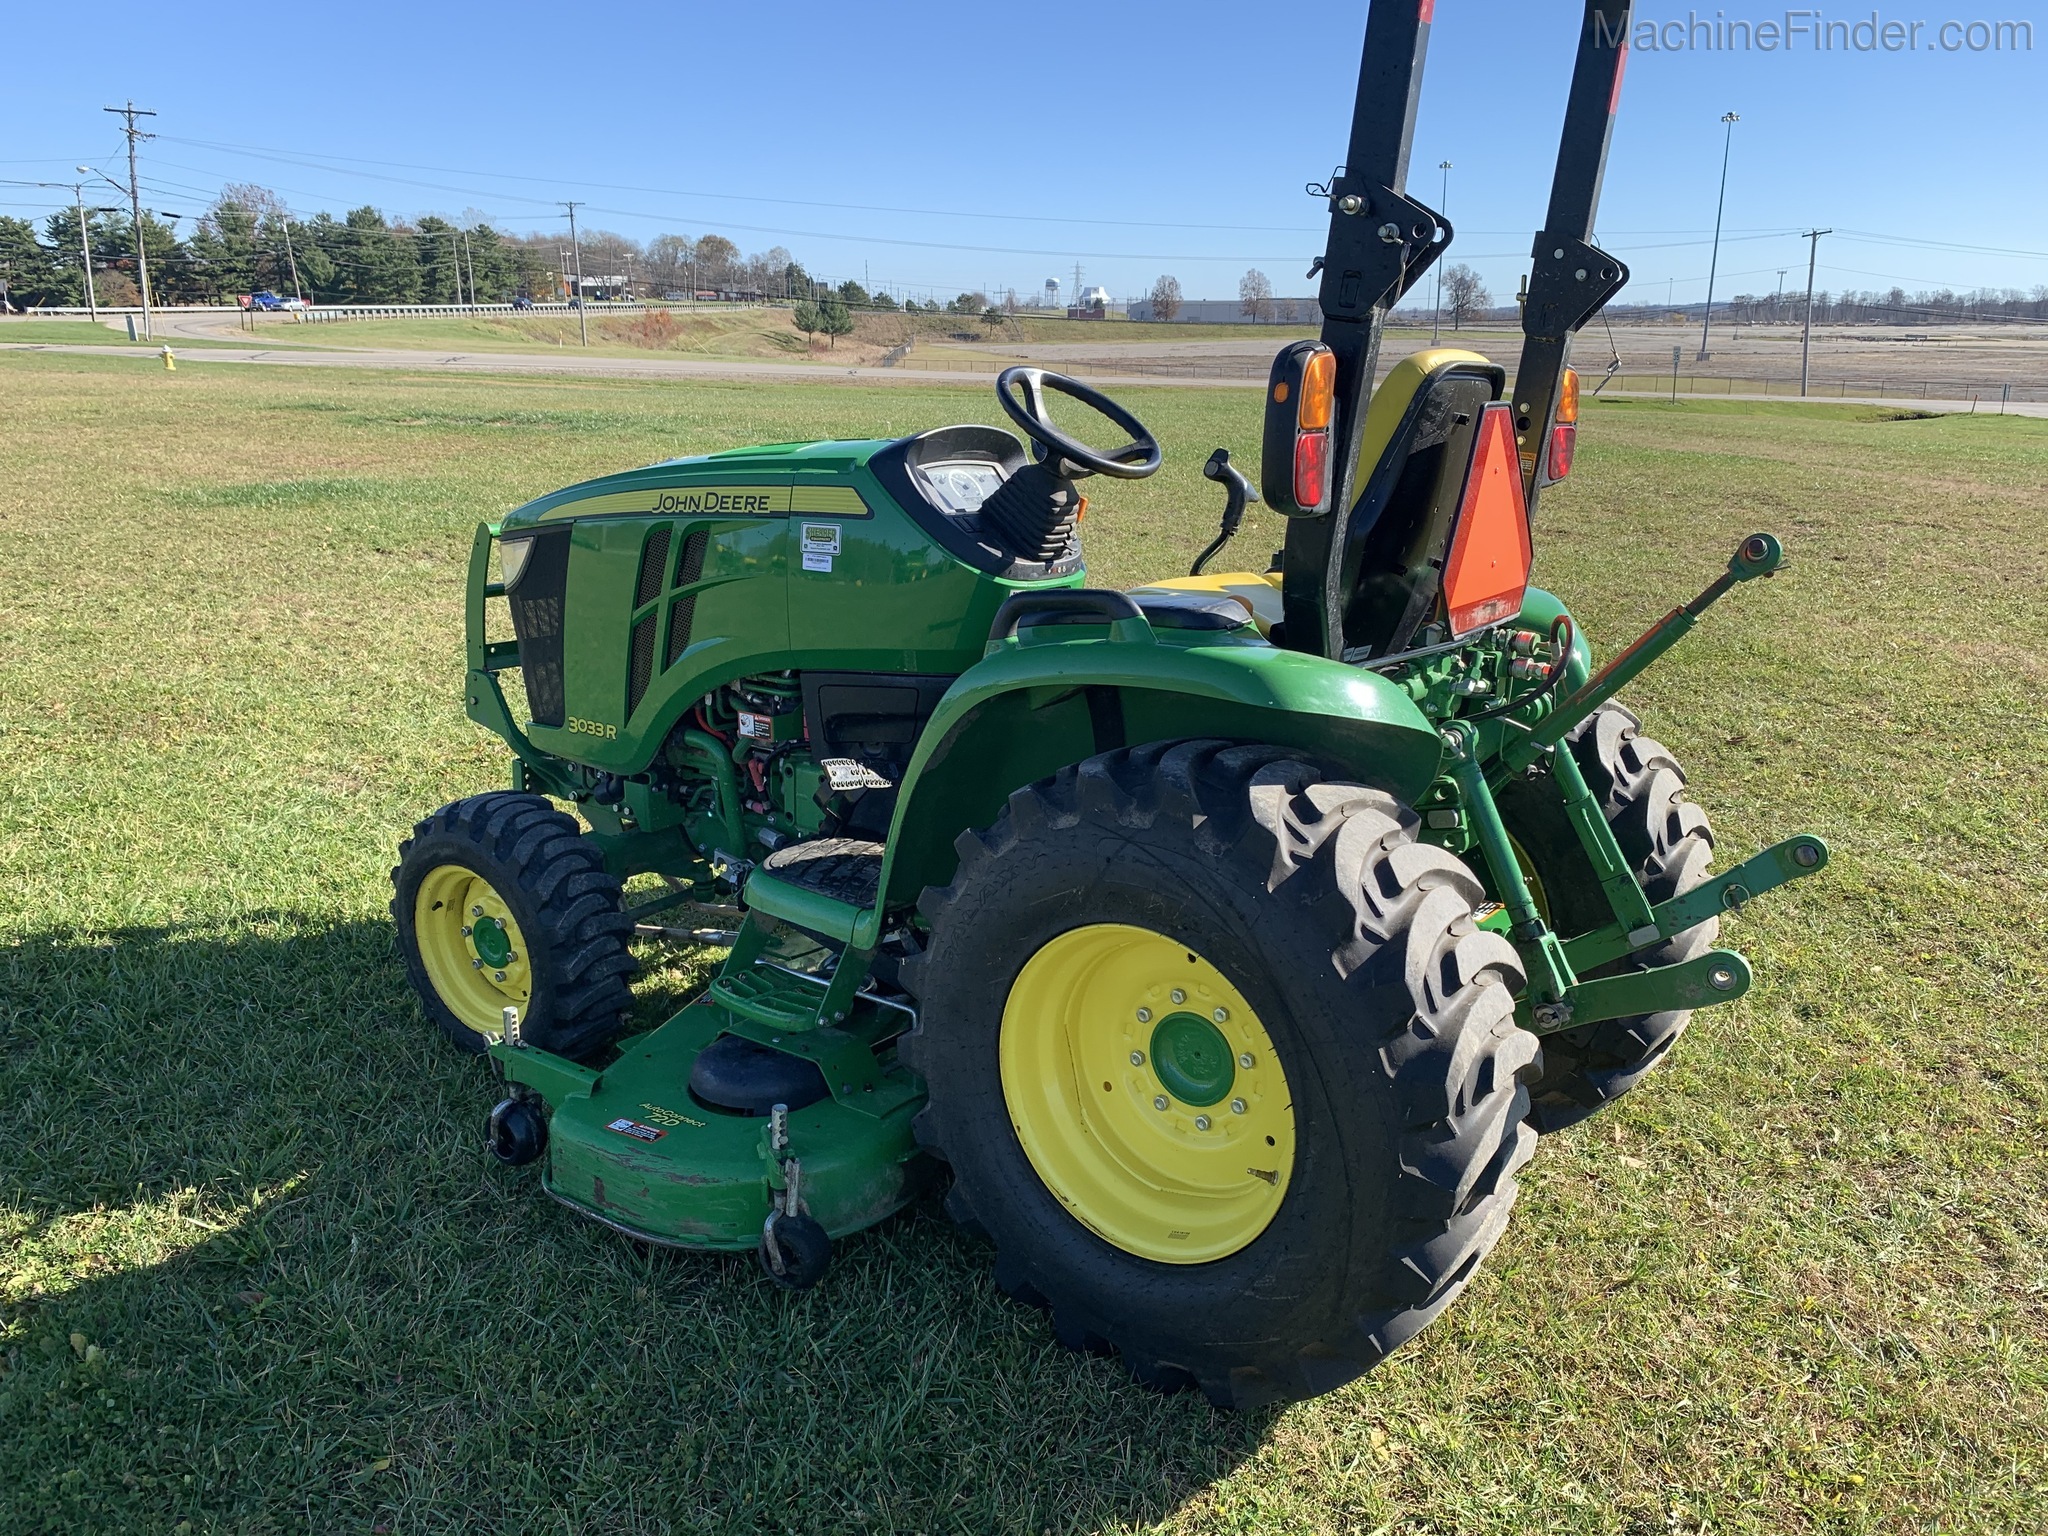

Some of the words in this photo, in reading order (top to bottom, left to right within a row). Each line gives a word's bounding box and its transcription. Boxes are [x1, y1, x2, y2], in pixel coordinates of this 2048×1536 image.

[651, 492, 702, 512] JOHN
[703, 491, 771, 511] DEERE
[638, 1102, 707, 1128] AutoConnect
[643, 1111, 681, 1127] 72D
